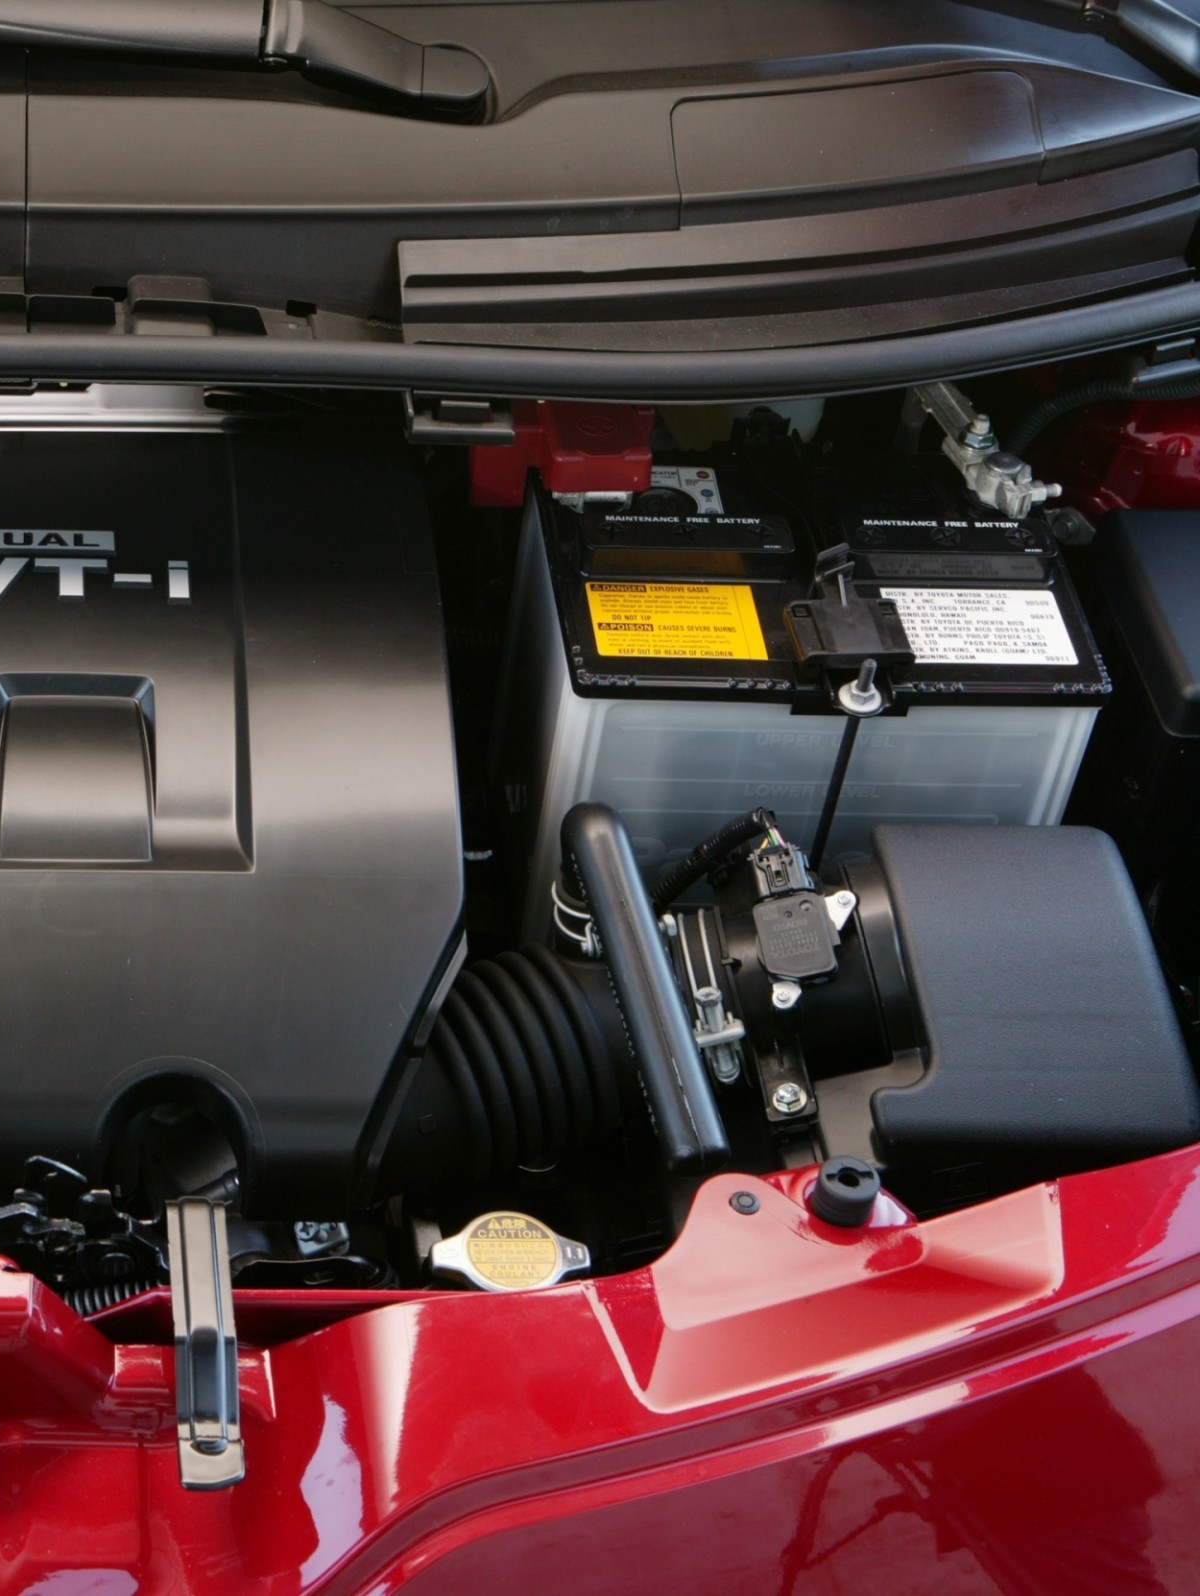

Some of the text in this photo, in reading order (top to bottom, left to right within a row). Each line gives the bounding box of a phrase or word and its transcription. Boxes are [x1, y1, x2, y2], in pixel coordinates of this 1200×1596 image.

[605, 514, 761, 525] MAINTENANCE FREE BATTERY
[863, 519, 1019, 529] MAINTENANCE FREE BATTERY
[602, 584, 645, 592] DANGER
[649, 585, 685, 593] EXPLOSIVE
[610, 623, 653, 631] POISON
[756, 734, 896, 749] UPPER LVEL
[744, 783, 814, 798] LOWER
[477, 1229, 543, 1239] CAUTION
